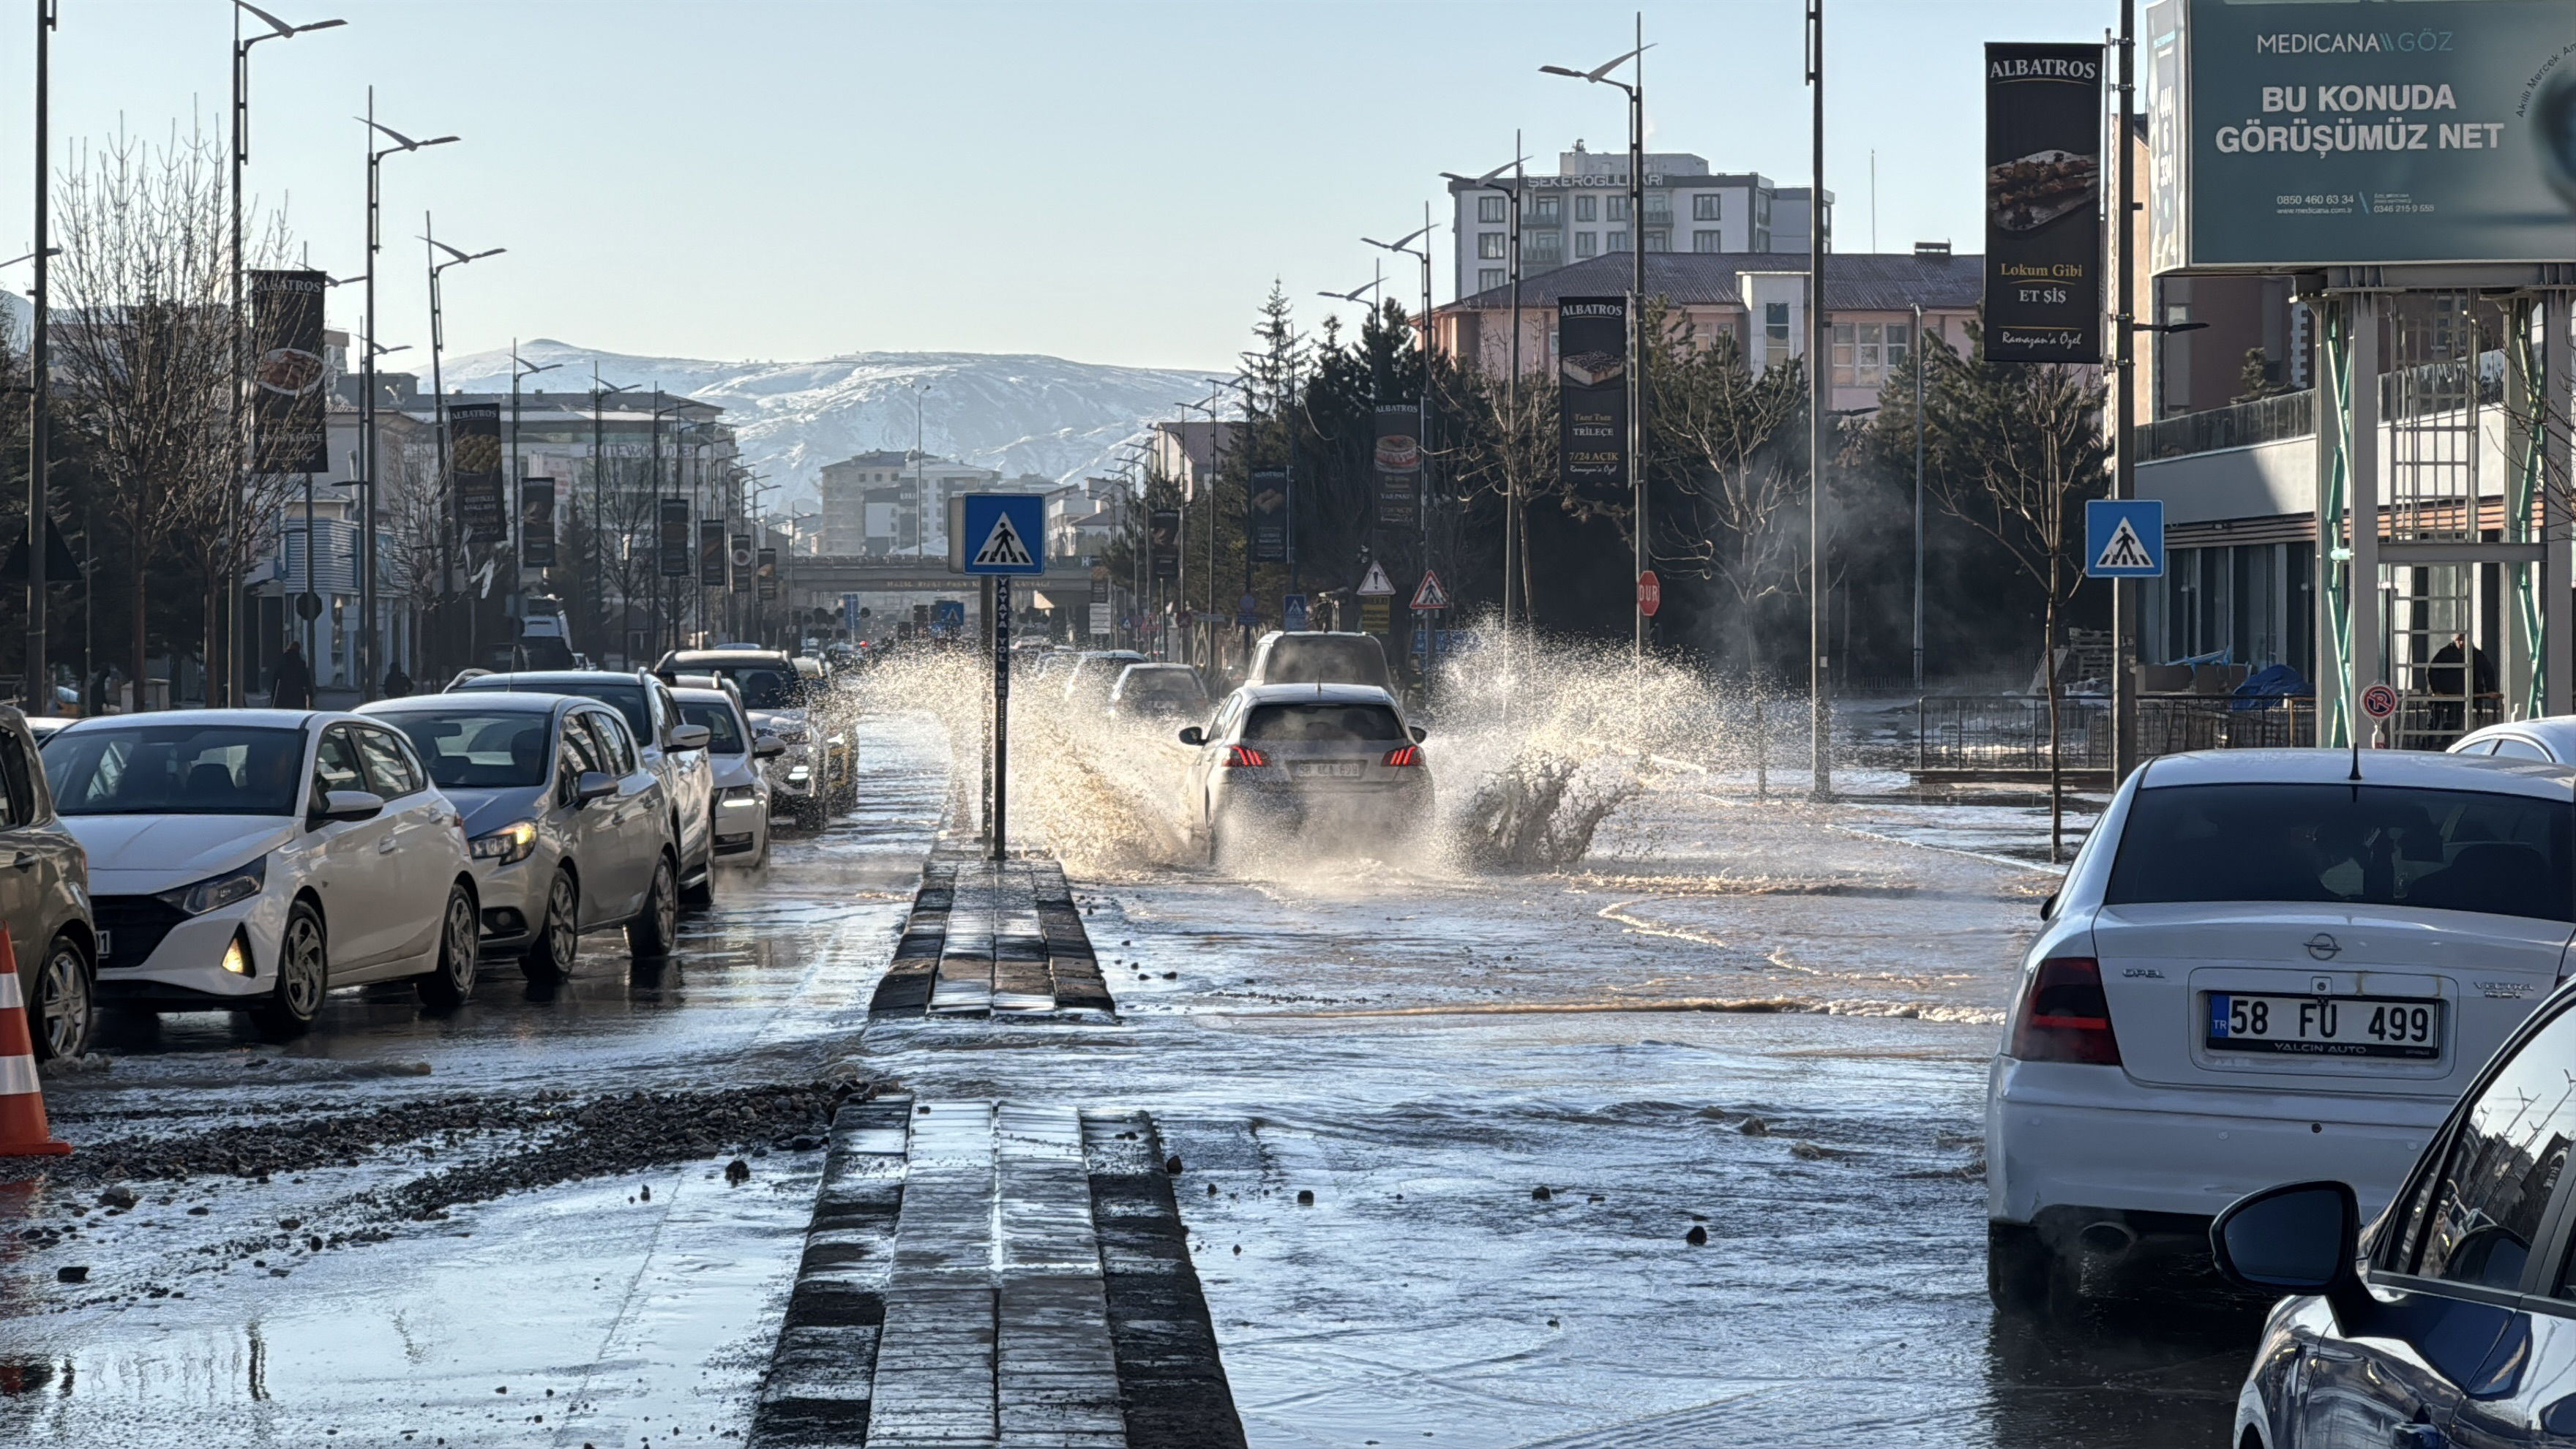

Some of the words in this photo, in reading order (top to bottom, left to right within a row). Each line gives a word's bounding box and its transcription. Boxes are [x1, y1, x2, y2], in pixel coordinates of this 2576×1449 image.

[2257, 33, 2381, 54] MEDICANA
[2397, 28, 2454, 52] GÖZ
[1990, 59, 2096, 80] ALBATROS
[2527, 53, 2561, 89] Mercek
[2262, 86, 2307, 113] BU
[2318, 83, 2457, 112] KONUDA
[2163, 121, 2169, 152] 6
[2215, 117, 2429, 160] GÖRÜŞÜMÜZ
[2439, 122, 2505, 149] NET
[2277, 195, 2302, 205] 0850
[2304, 195, 2324, 205] 460
[2326, 195, 2340, 204] 63
[2341, 194, 2354, 204] 34
[2001, 263, 2048, 277] Lokum
[2052, 263, 2083, 277] Gibi
[2018, 289, 2040, 302] ET
[2043, 287, 2067, 304] ŞİŞ
[1561, 304, 1623, 317] ALBATROS
[2002, 331, 2057, 349] Ramazan'a
[2059, 331, 2082, 350] Özel
[452, 409, 497, 420] ALBATROS
[1375, 404, 1418, 413] ALBATROS
[1573, 425, 1614, 438] TRİLEÇE
[1569, 452, 1590, 461] 7/24
[1639, 584, 1658, 602] DUR
[997, 577, 1008, 628] YAYAYA
[997, 637, 1007, 662] YOL
[997, 671, 1007, 696] VER
[2122, 968, 2165, 979] OPEL
[2473, 981, 2535, 992] VECTRA
[2214, 1019, 2227, 1030] TR
[2231, 1000, 2269, 1036] 58
[2299, 1003, 2337, 1038] FU
[2367, 1006, 2429, 1043] 499
[2328, 1044, 2367, 1055] AUTO
